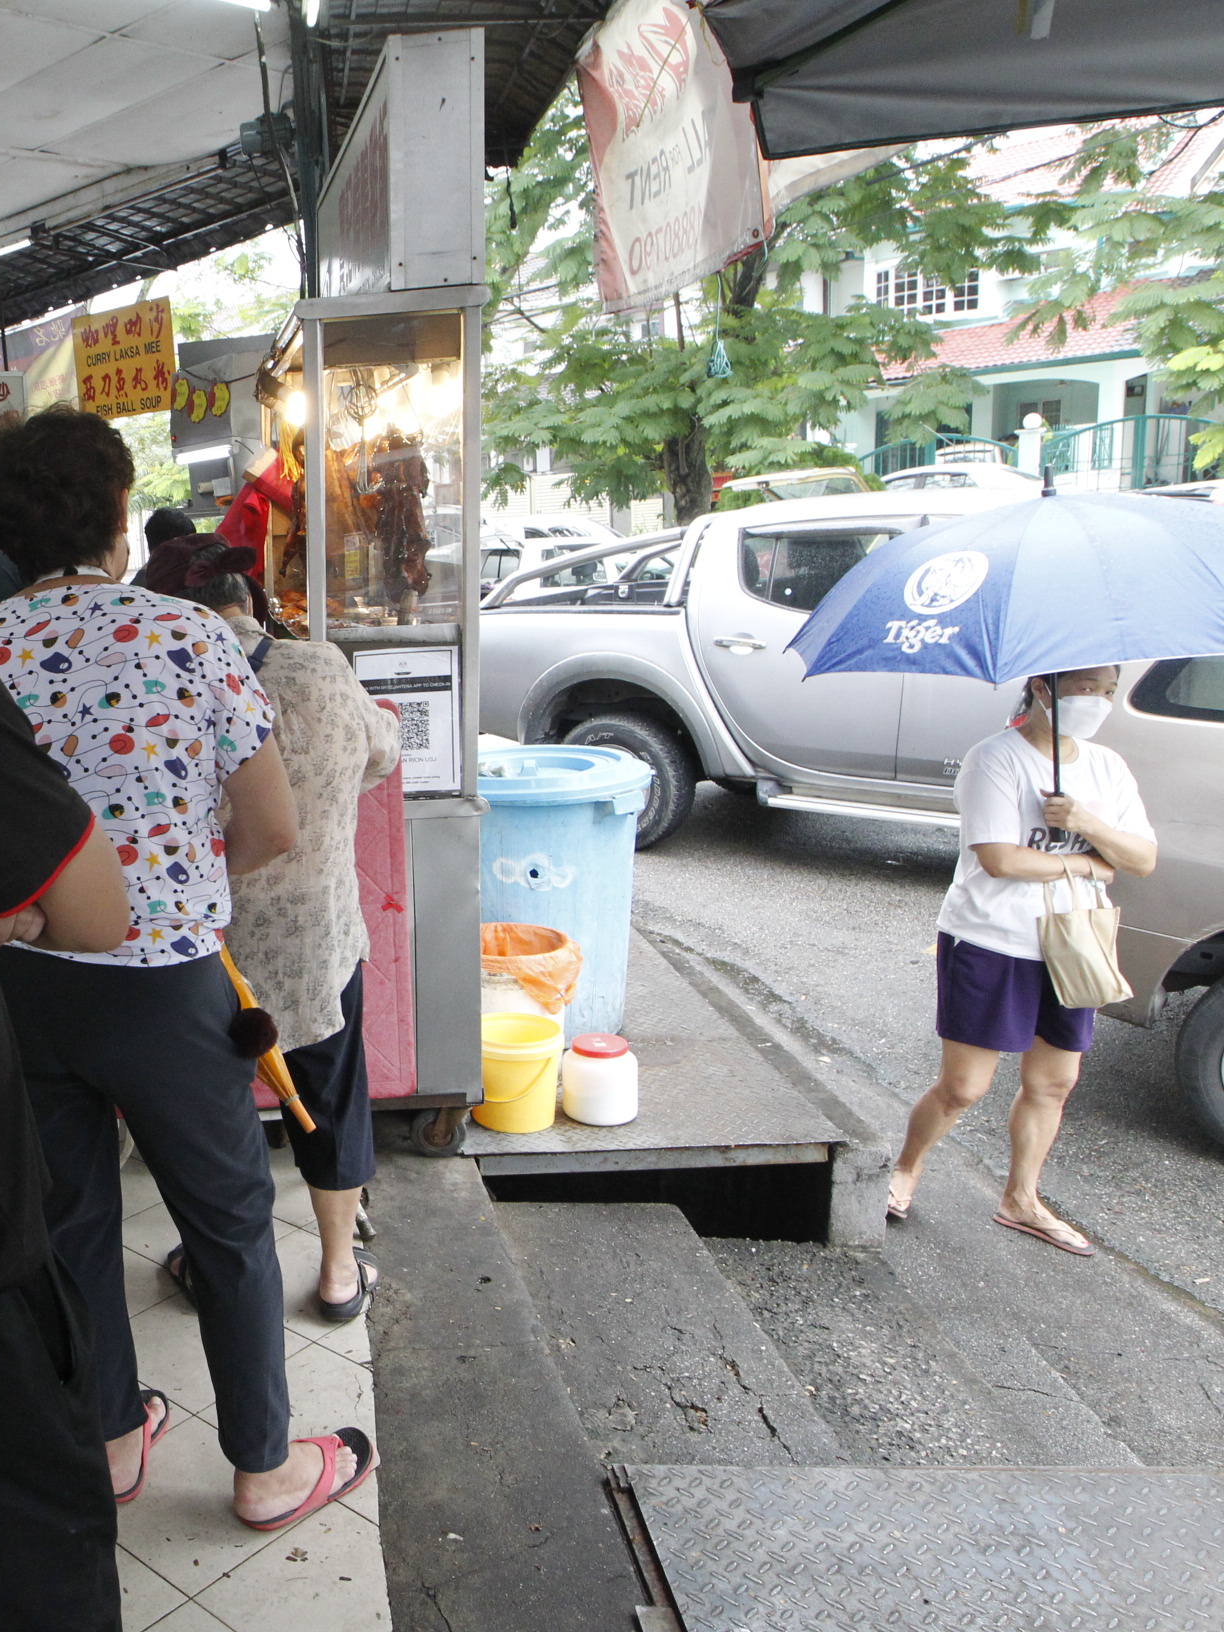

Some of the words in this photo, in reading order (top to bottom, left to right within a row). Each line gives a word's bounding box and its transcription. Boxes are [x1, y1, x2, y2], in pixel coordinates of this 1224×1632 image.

[86, 352, 111, 367] CURRY
[114, 346, 141, 361] LAKSA
[144, 339, 161, 355] MEE
[96, 403, 113, 416] FISH
[116, 400, 137, 414] BALL
[140, 395, 162, 409] SOUP
[882, 619, 960, 654] Tiger
